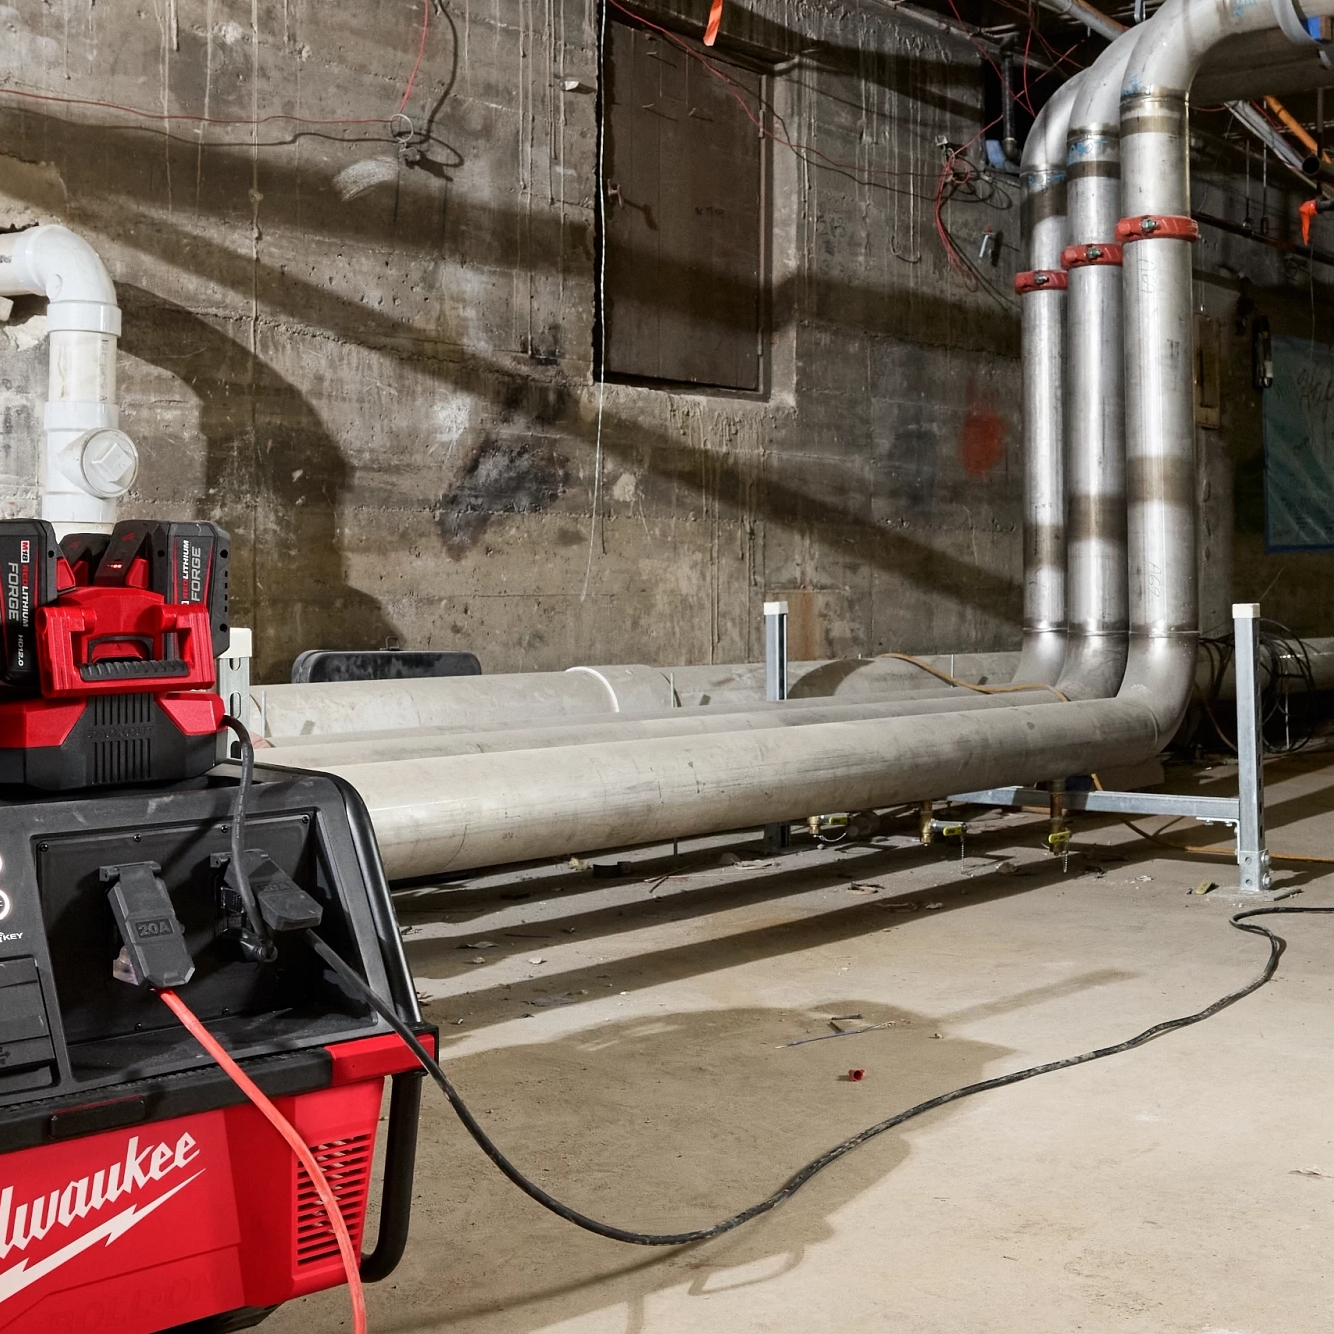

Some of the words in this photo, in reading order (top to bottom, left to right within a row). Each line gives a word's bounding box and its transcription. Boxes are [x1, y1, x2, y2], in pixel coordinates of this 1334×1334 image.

[21, 541, 30, 563] M18
[7, 562, 19, 622] FORGE
[191, 546, 201, 602] FORGE
[138, 919, 172, 937] 20A
